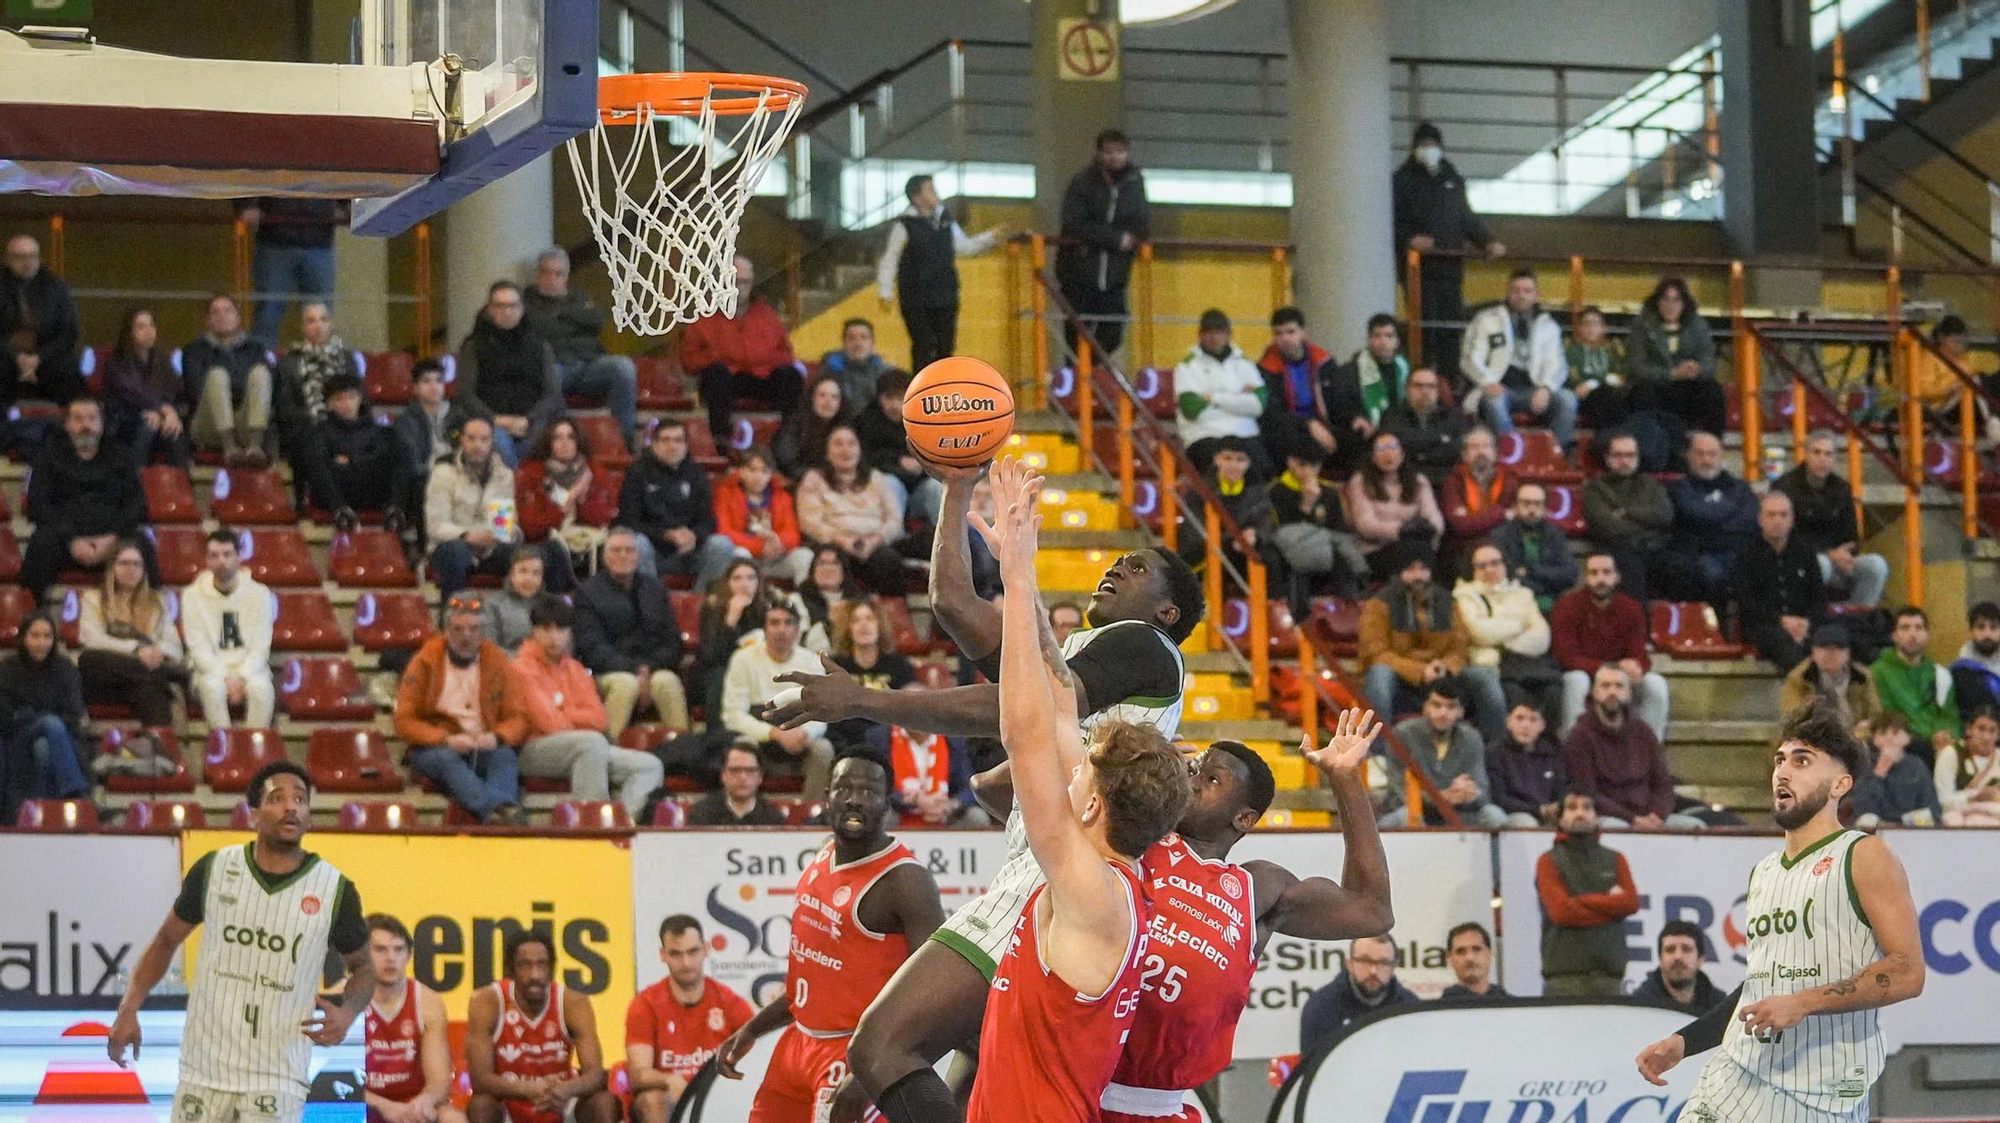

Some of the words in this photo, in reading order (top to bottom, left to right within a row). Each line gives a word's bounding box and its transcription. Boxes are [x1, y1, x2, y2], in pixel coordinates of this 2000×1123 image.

[921, 393, 996, 415] Wilson
[938, 434, 982, 449] EVO
[727, 848, 786, 875] San
[1167, 875, 1204, 898] CAJA
[1205, 891, 1245, 928] RURAL
[1148, 928, 1175, 947] LEÓN
[1747, 907, 1797, 940] coto
[223, 925, 286, 953] coto
[1152, 914, 1229, 971] E.Leclerc
[1139, 954, 1188, 1003] 25
[1778, 963, 1821, 981] Cajasol
[795, 976, 809, 1009] 0
[245, 1002, 260, 1039] 4
[1518, 1080, 1607, 1097] GRUPO
